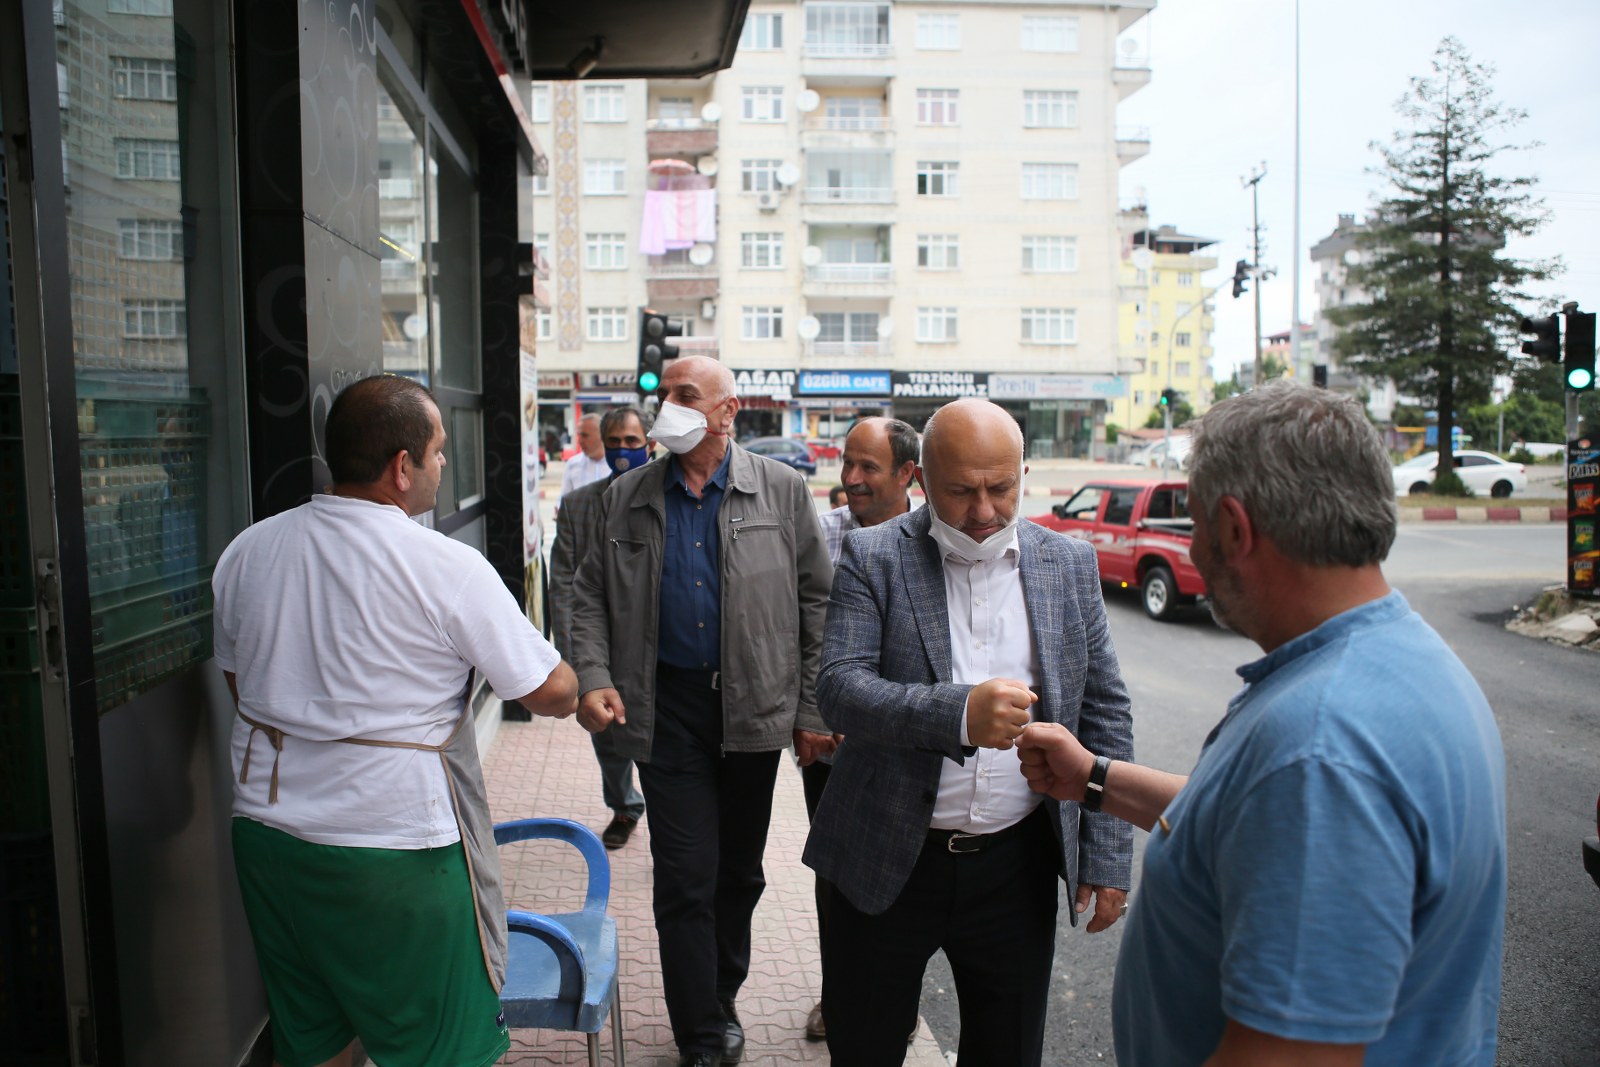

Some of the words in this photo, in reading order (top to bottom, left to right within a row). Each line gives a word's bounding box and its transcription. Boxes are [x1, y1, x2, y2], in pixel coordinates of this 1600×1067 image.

[735, 370, 796, 385] AĞAN
[803, 372, 851, 389] ÖZGÜR
[853, 377, 887, 388] CAFE
[893, 383, 988, 397] PASLANMAZ
